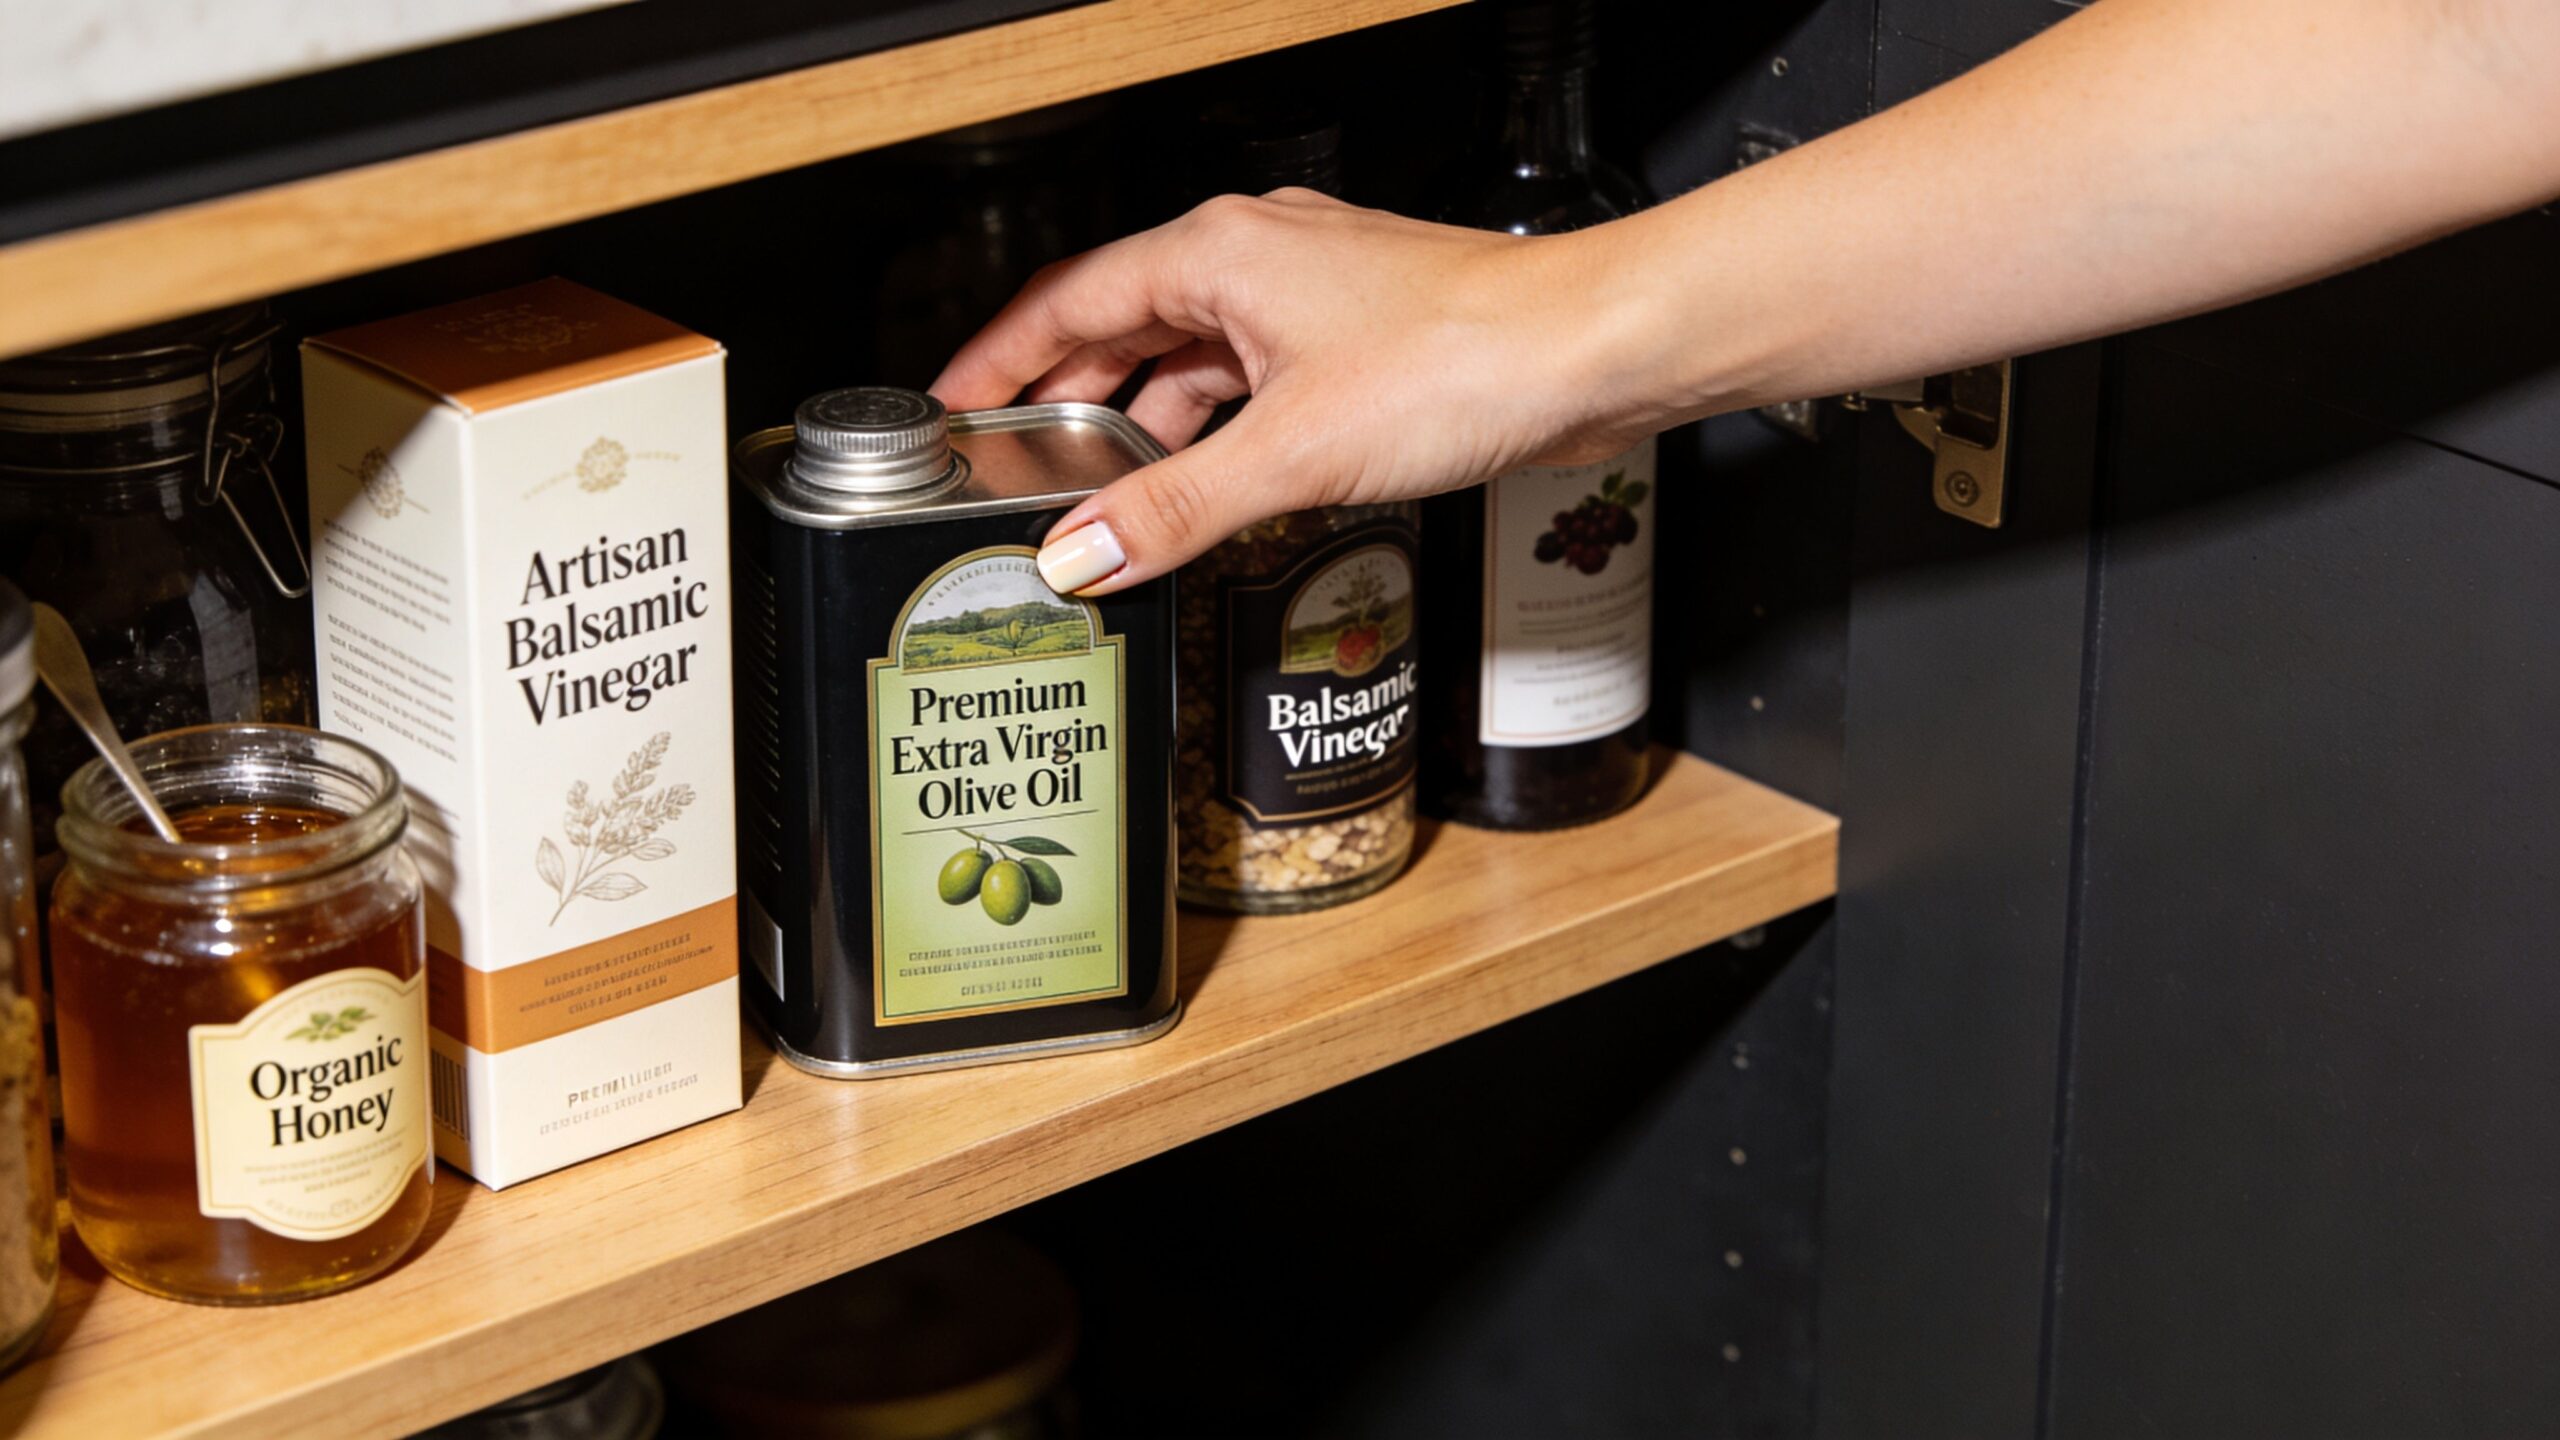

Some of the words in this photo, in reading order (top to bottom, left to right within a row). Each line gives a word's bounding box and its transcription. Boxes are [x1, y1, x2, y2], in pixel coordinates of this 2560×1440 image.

[520, 526, 688, 606] Artisan
[505, 577, 708, 671] Balsamic
[518, 642, 697, 728] Vinegar
[910, 677, 1086, 726] Premium
[1267, 662, 1417, 731] Balsamic
[891, 734, 988, 776] Extra
[998, 719, 1107, 766] Virgin
[919, 778, 1016, 820] Olive
[1027, 762, 1082, 807] Oil
[250, 1035, 403, 1103] Organic
[271, 1087, 393, 1147] Honey
